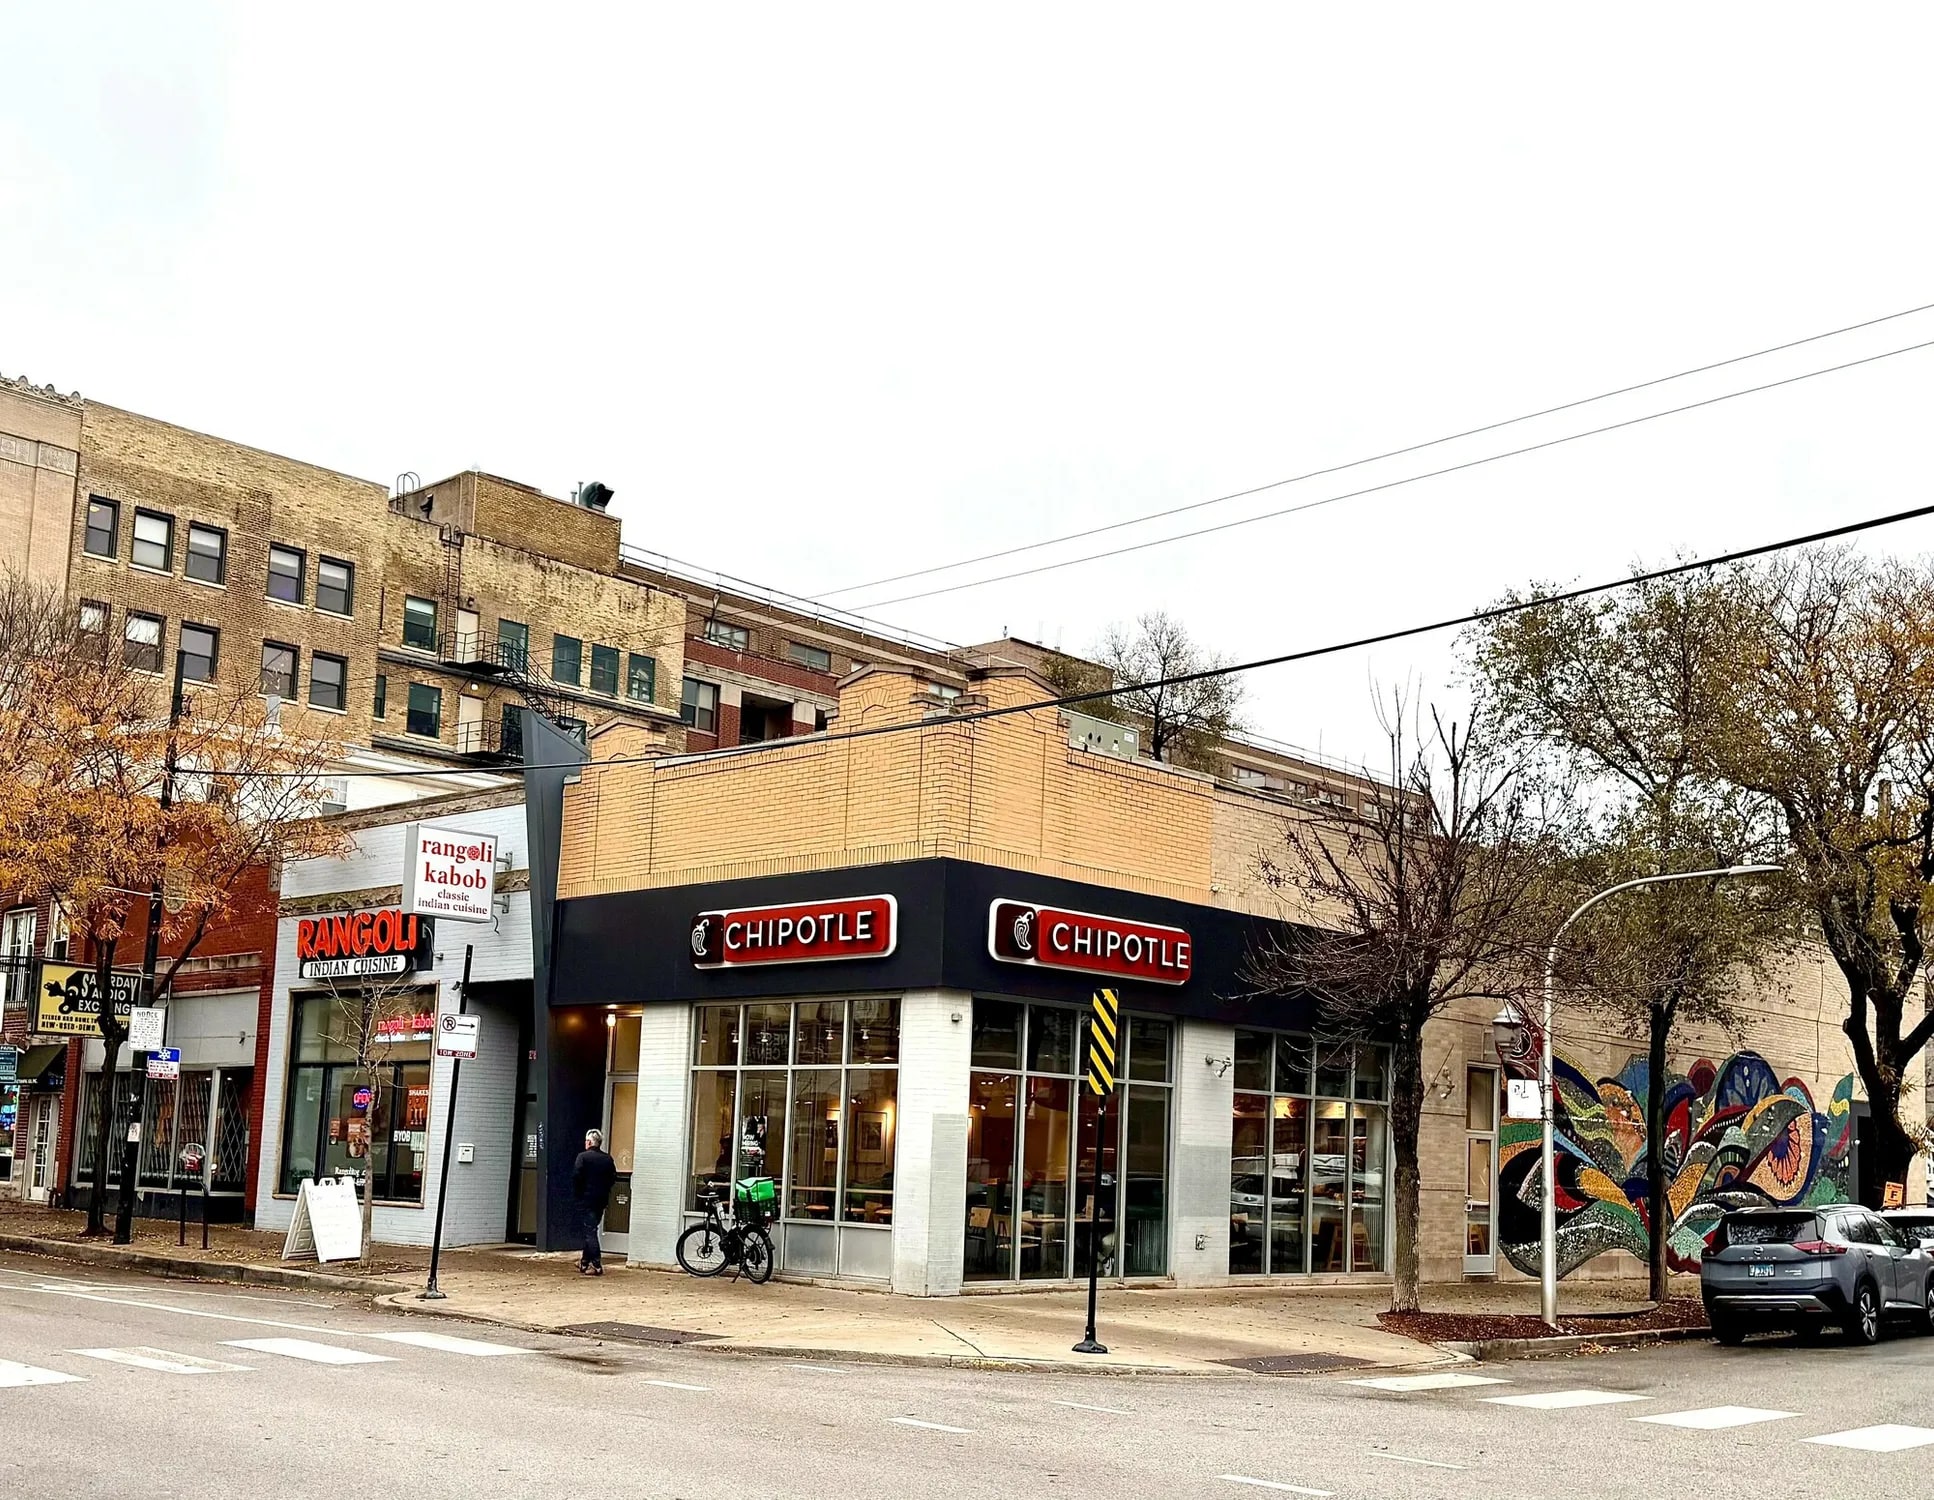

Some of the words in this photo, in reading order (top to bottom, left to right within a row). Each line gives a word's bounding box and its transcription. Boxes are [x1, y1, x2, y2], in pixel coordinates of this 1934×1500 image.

[421, 839, 493, 864] rangoli
[424, 861, 487, 889] kabob
[437, 888, 470, 901] classic
[452, 903, 488, 914] cuisine
[297, 909, 417, 959] RANGOLI
[725, 910, 873, 949] CHIPOTLE
[1052, 922, 1190, 969] CHIPOTLE
[309, 960, 350, 977] INDIAN
[353, 956, 398, 974] CUISINE
[81, 973, 138, 1002] SARDAY
[78, 999, 137, 1015] EXCNG
[456, 1050, 473, 1058] ZONE
[393, 1130, 411, 1142] BYOB
